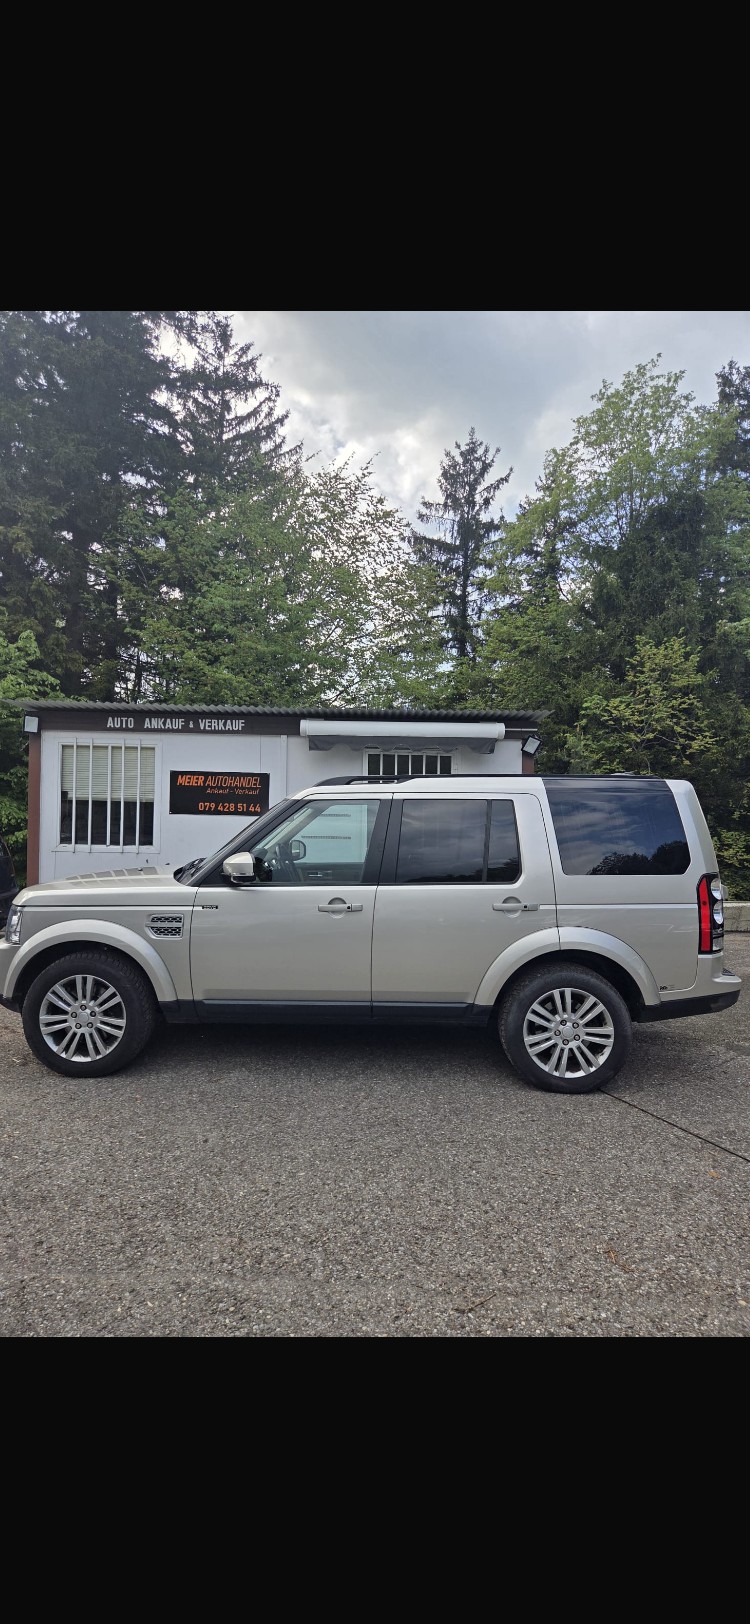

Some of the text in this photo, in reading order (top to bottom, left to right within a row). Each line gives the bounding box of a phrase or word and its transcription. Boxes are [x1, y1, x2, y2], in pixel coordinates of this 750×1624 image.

[106, 716, 134, 728] AUTO
[144, 717, 185, 730] ANKAUF
[198, 718, 245, 730] VERKAUF
[176, 775, 262, 788] MEIER AUTOHANDEL
[198, 802, 261, 812] 079 428 51 44
